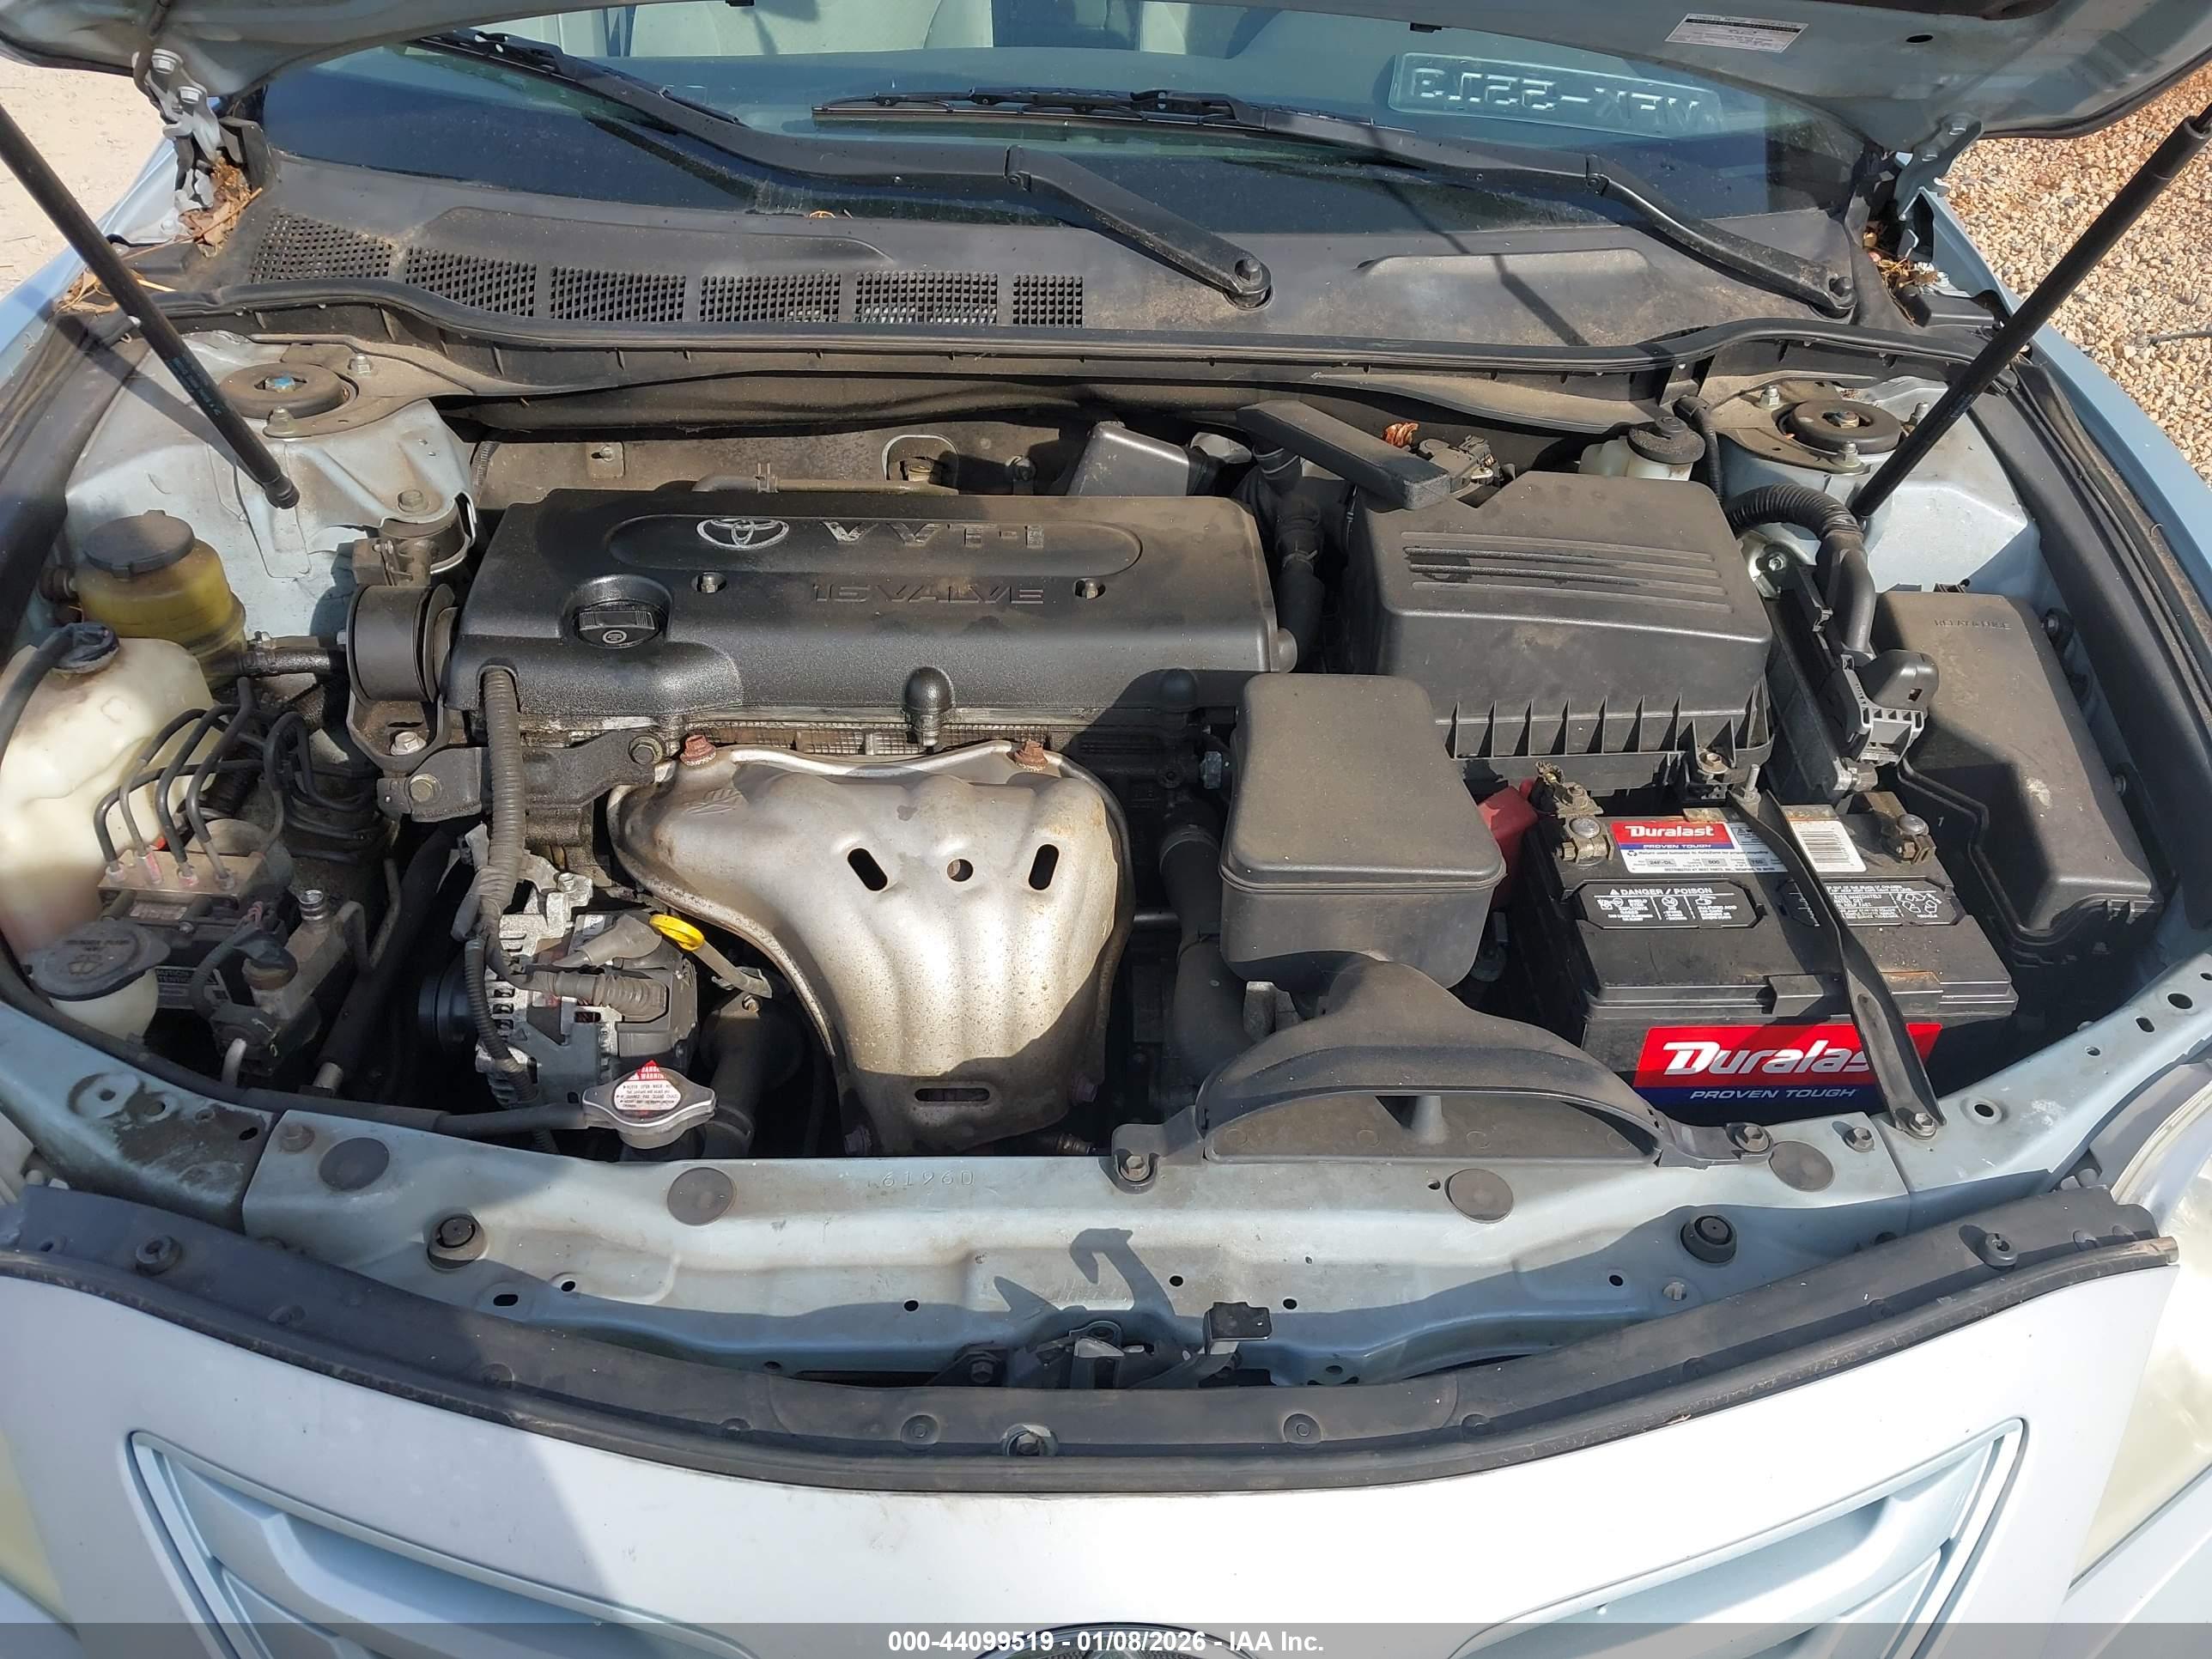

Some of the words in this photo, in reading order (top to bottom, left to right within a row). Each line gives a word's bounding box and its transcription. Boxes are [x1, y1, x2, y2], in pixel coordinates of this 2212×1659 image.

[876, 584, 1045, 605] VALVE
[1624, 825, 1715, 838] Duralast
[1662, 1040, 1870, 1075] Duralas
[1690, 1090, 1779, 1099] PROVEN
[1786, 1089, 1856, 1098] TOUGH
[882, 1170, 974, 1186] 61960
